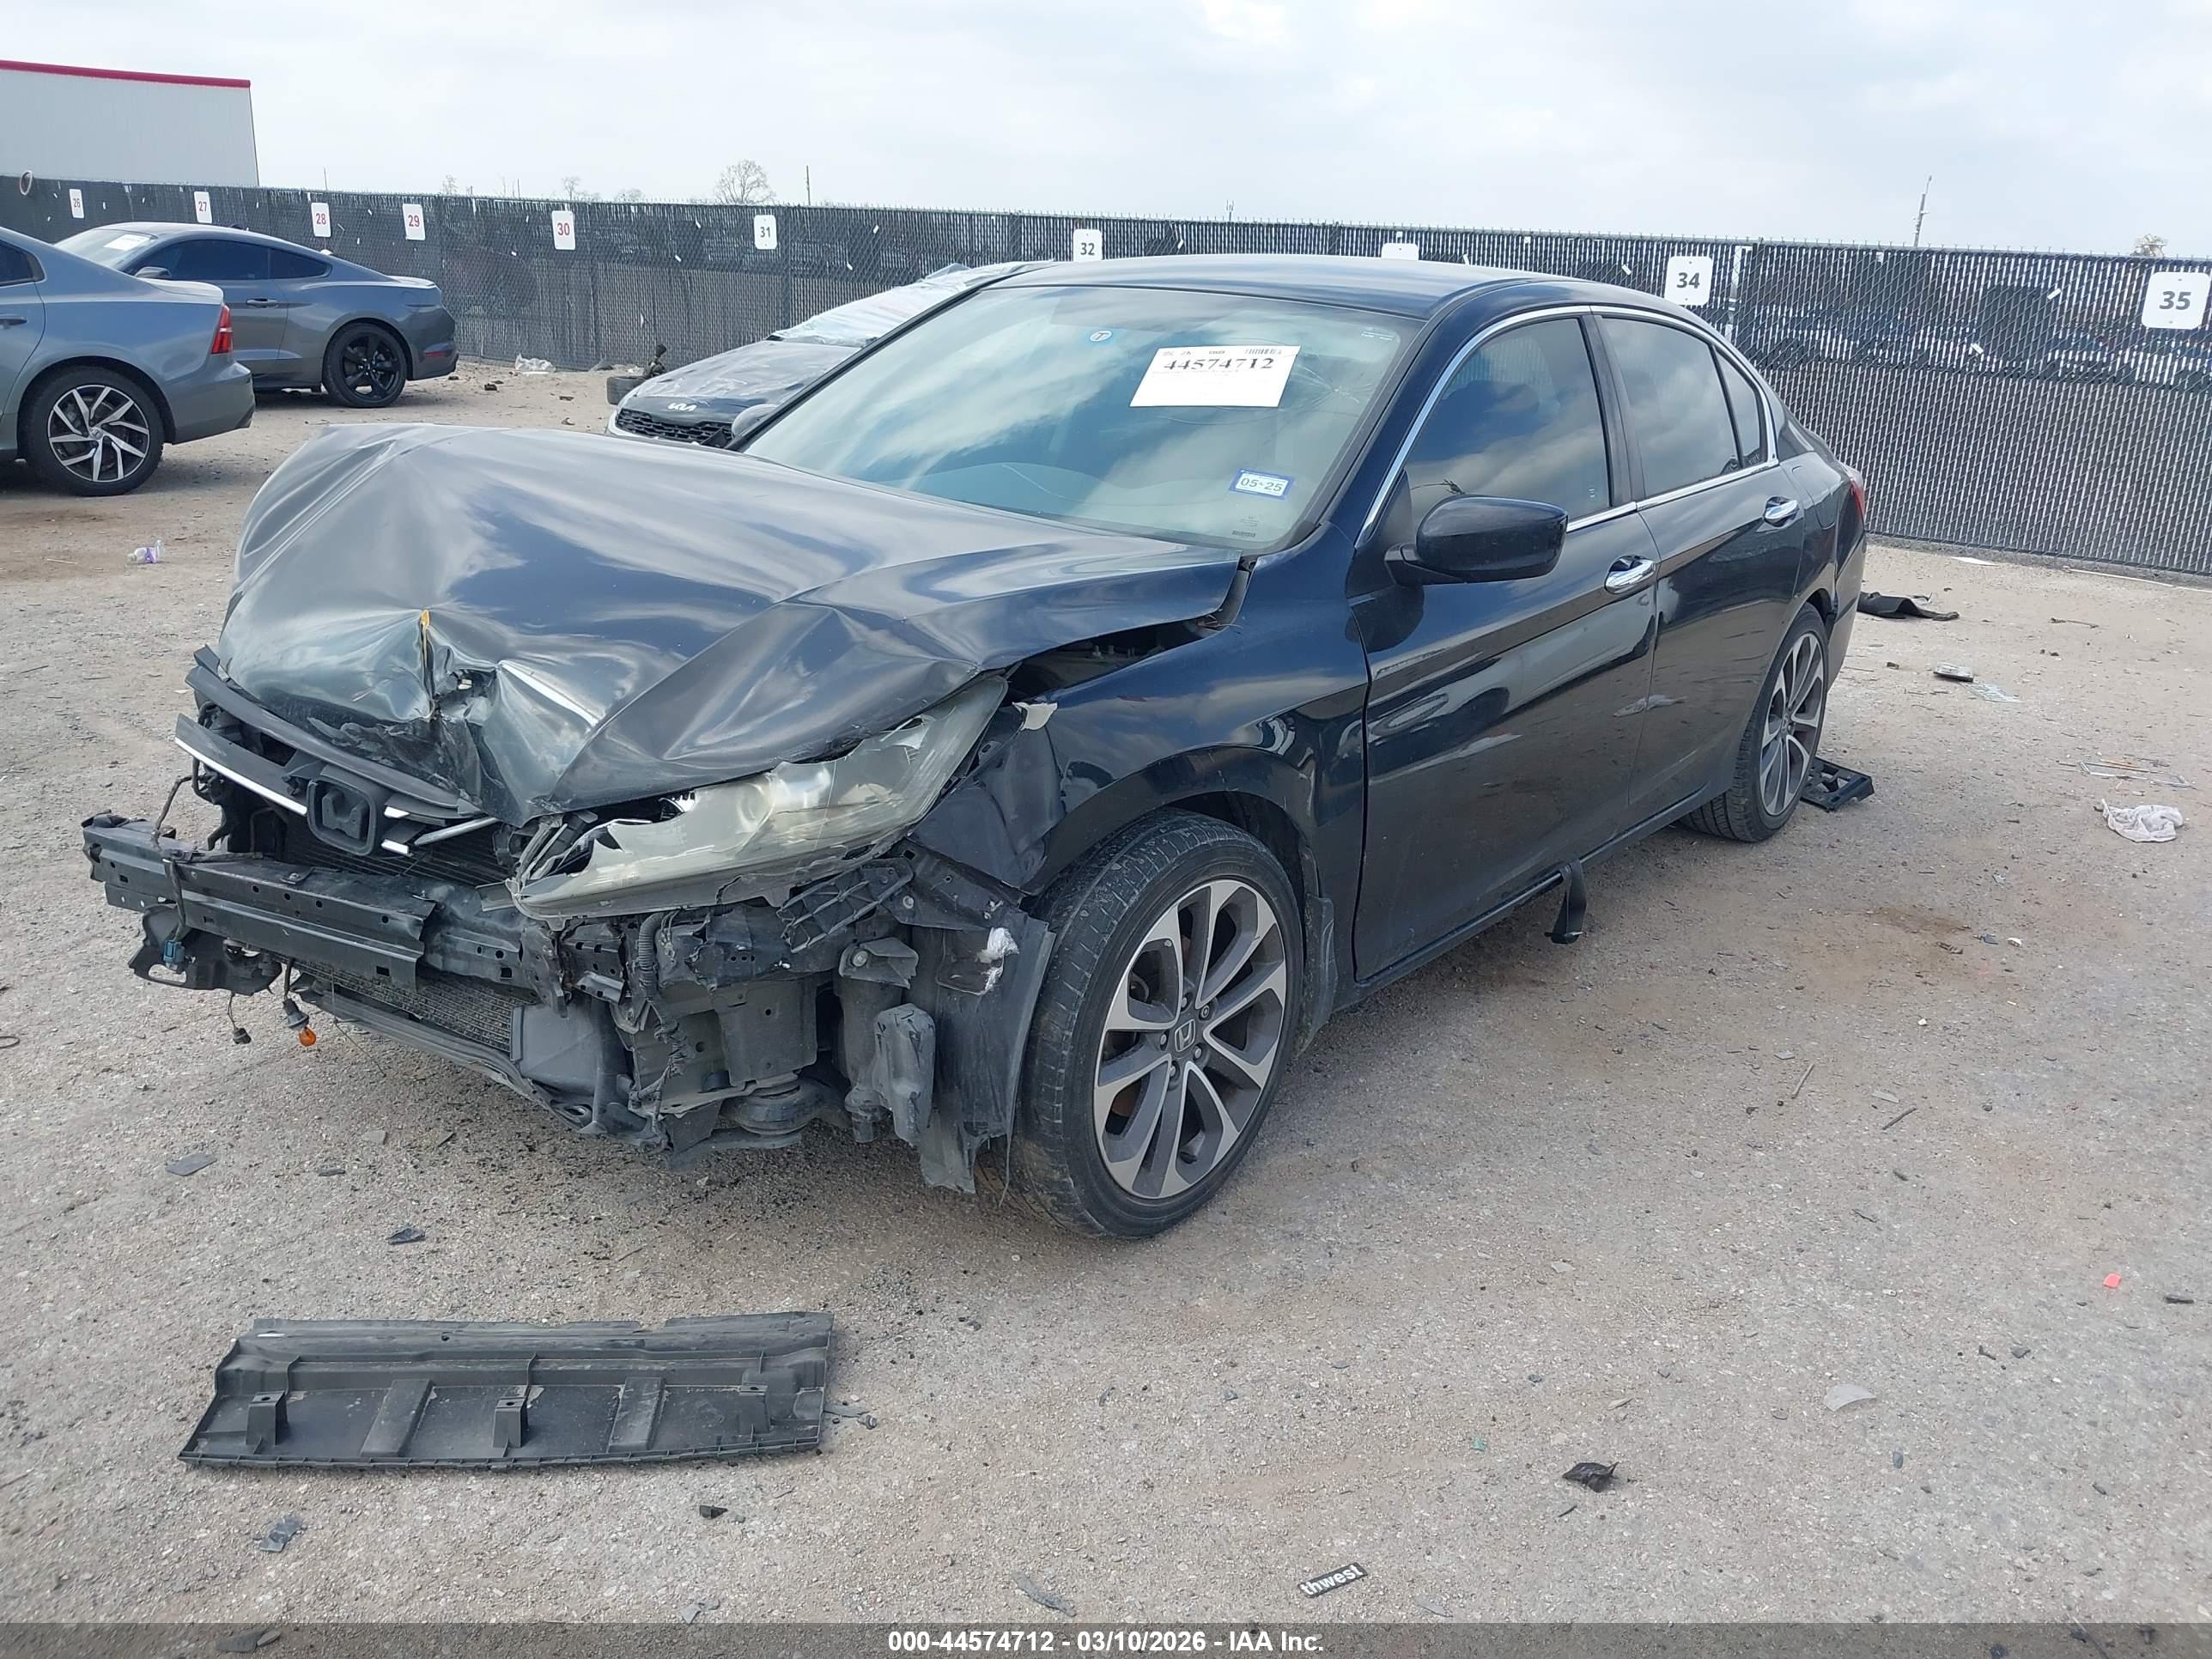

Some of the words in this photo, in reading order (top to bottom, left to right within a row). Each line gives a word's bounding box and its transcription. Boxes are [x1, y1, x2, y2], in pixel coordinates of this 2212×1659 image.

[72, 198, 81, 208] 26
[198, 201, 207, 212] 27
[315, 213, 326, 225] 28
[408, 215, 420, 228] 29
[557, 222, 570, 235] 30
[760, 227, 771, 238] 31
[1080, 242, 1095, 256] 32
[1676, 272, 1700, 289] 34
[2159, 290, 2192, 310] 35
[1164, 357, 1274, 370] 44574712
[1299, 1564, 1364, 1595] thwest
